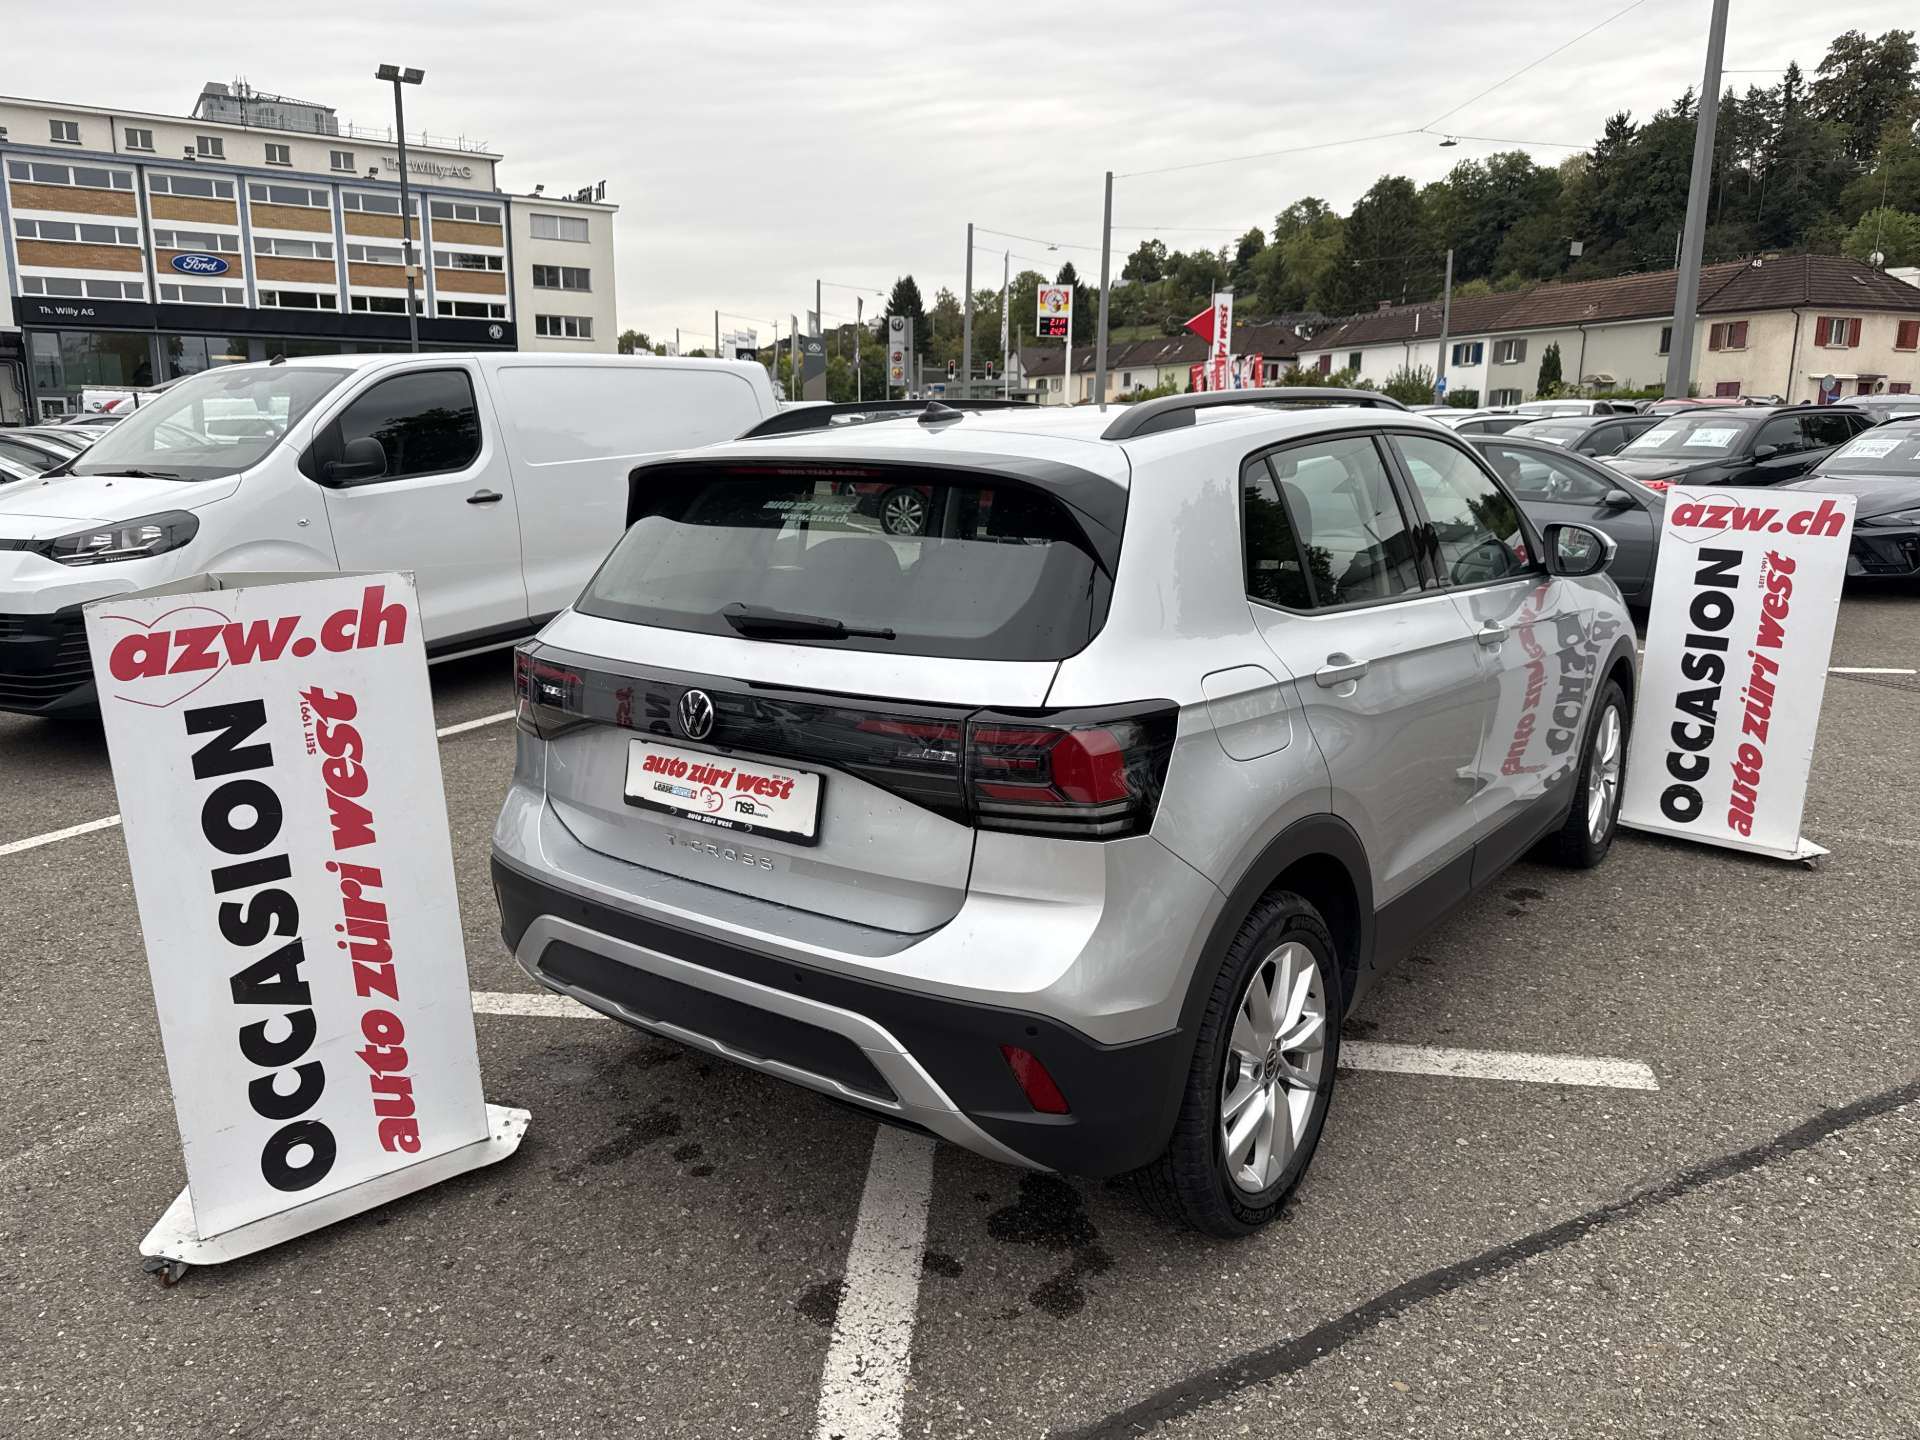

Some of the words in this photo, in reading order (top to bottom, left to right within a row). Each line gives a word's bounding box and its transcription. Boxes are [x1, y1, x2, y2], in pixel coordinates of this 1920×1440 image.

[411, 159, 446, 178] Willy
[450, 162, 472, 178] AG
[183, 257, 217, 272] Ford
[1752, 259, 1762, 267] 48
[39, 306, 53, 315] Th.
[56, 306, 78, 317] Willy
[81, 307, 95, 316] AG
[1671, 500, 1846, 537] azw.ch
[1756, 551, 1796, 649] west
[109, 585, 407, 681] azw.ch
[1660, 547, 1743, 823] OCCASION
[1739, 650, 1779, 745] züri
[299, 701, 312, 727] 1991
[304, 732, 317, 755] SEIT
[299, 687, 376, 850] west
[643, 755, 689, 778] auto
[687, 762, 737, 788] züri
[736, 773, 795, 799] west
[1728, 742, 1763, 837] auto
[687, 812, 702, 821] auto
[717, 819, 733, 829] west
[735, 800, 755, 815] nsa
[664, 831, 774, 872] T-CROSS
[184, 698, 337, 1193] OCCASION
[326, 861, 399, 1001] züri
[356, 1009, 421, 1153] auto
